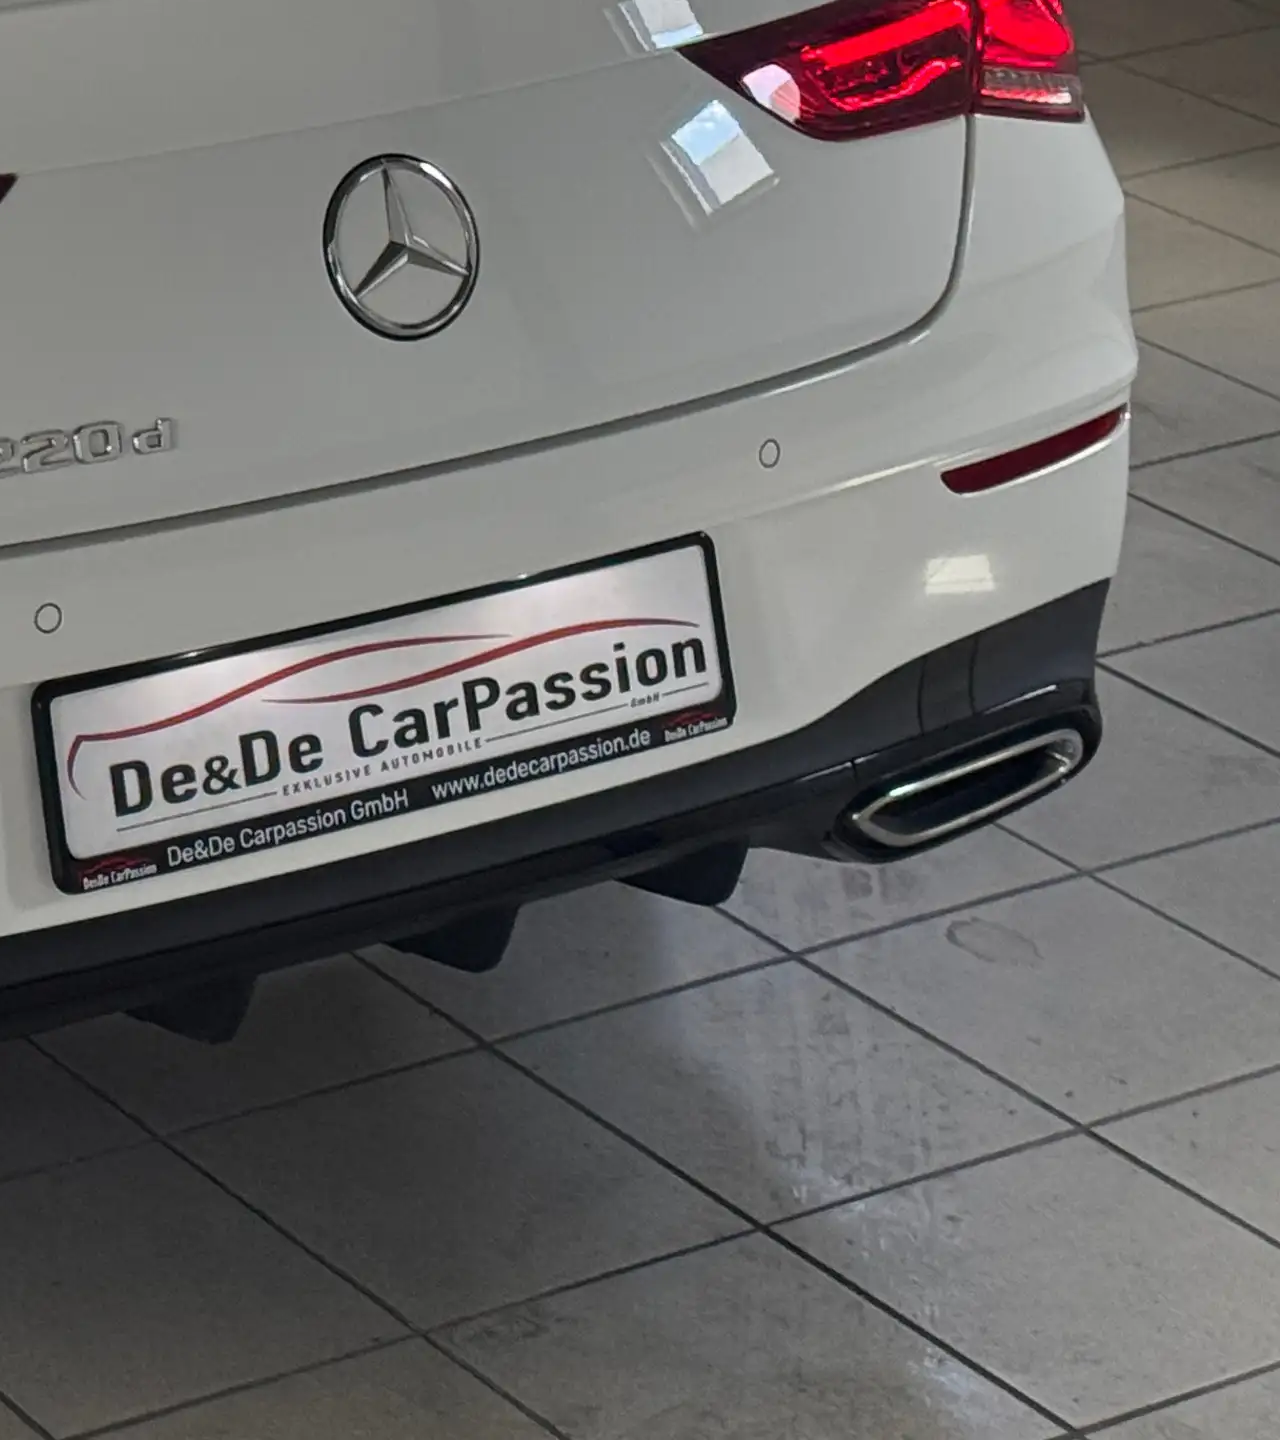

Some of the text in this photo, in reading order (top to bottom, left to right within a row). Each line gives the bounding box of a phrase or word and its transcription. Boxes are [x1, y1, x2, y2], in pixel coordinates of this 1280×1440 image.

[109, 635, 707, 818] De&De CarPassion
[166, 726, 651, 867] De&De Carpassion GmbH www.dedecarpassion.de
[282, 736, 484, 797] EXKLUSIVE AUTOMOBILE
